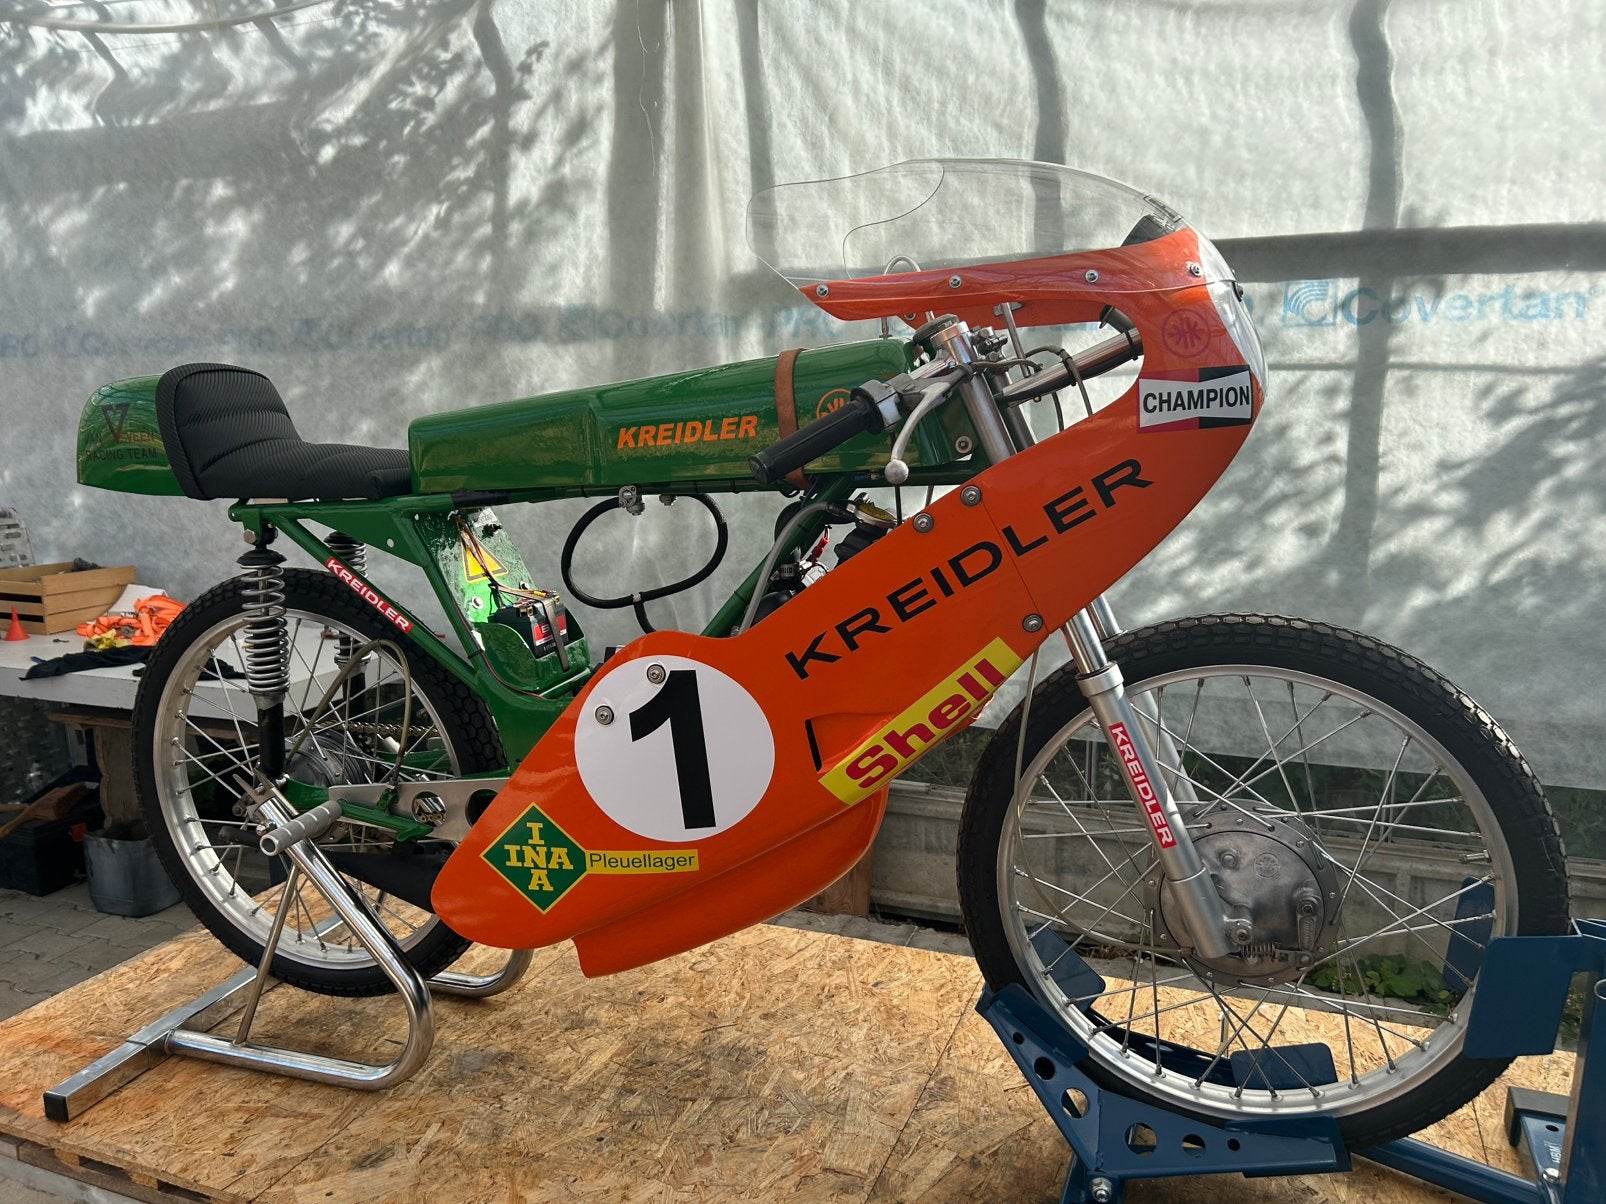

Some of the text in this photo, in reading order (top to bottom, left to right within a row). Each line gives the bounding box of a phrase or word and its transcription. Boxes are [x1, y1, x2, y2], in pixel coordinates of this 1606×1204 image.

[617, 415, 758, 449] KREIDLER
[1142, 385, 1250, 414] CHAMPION
[85, 447, 158, 461] RACING TEAM
[327, 559, 410, 631] KREIDLER
[784, 458, 1154, 680] KREIDLER
[629, 669, 716, 830] 1
[845, 658, 1006, 789] Shell
[1111, 726, 1173, 845] KREIDLER
[504, 844, 695, 871] INA Pleuellager
